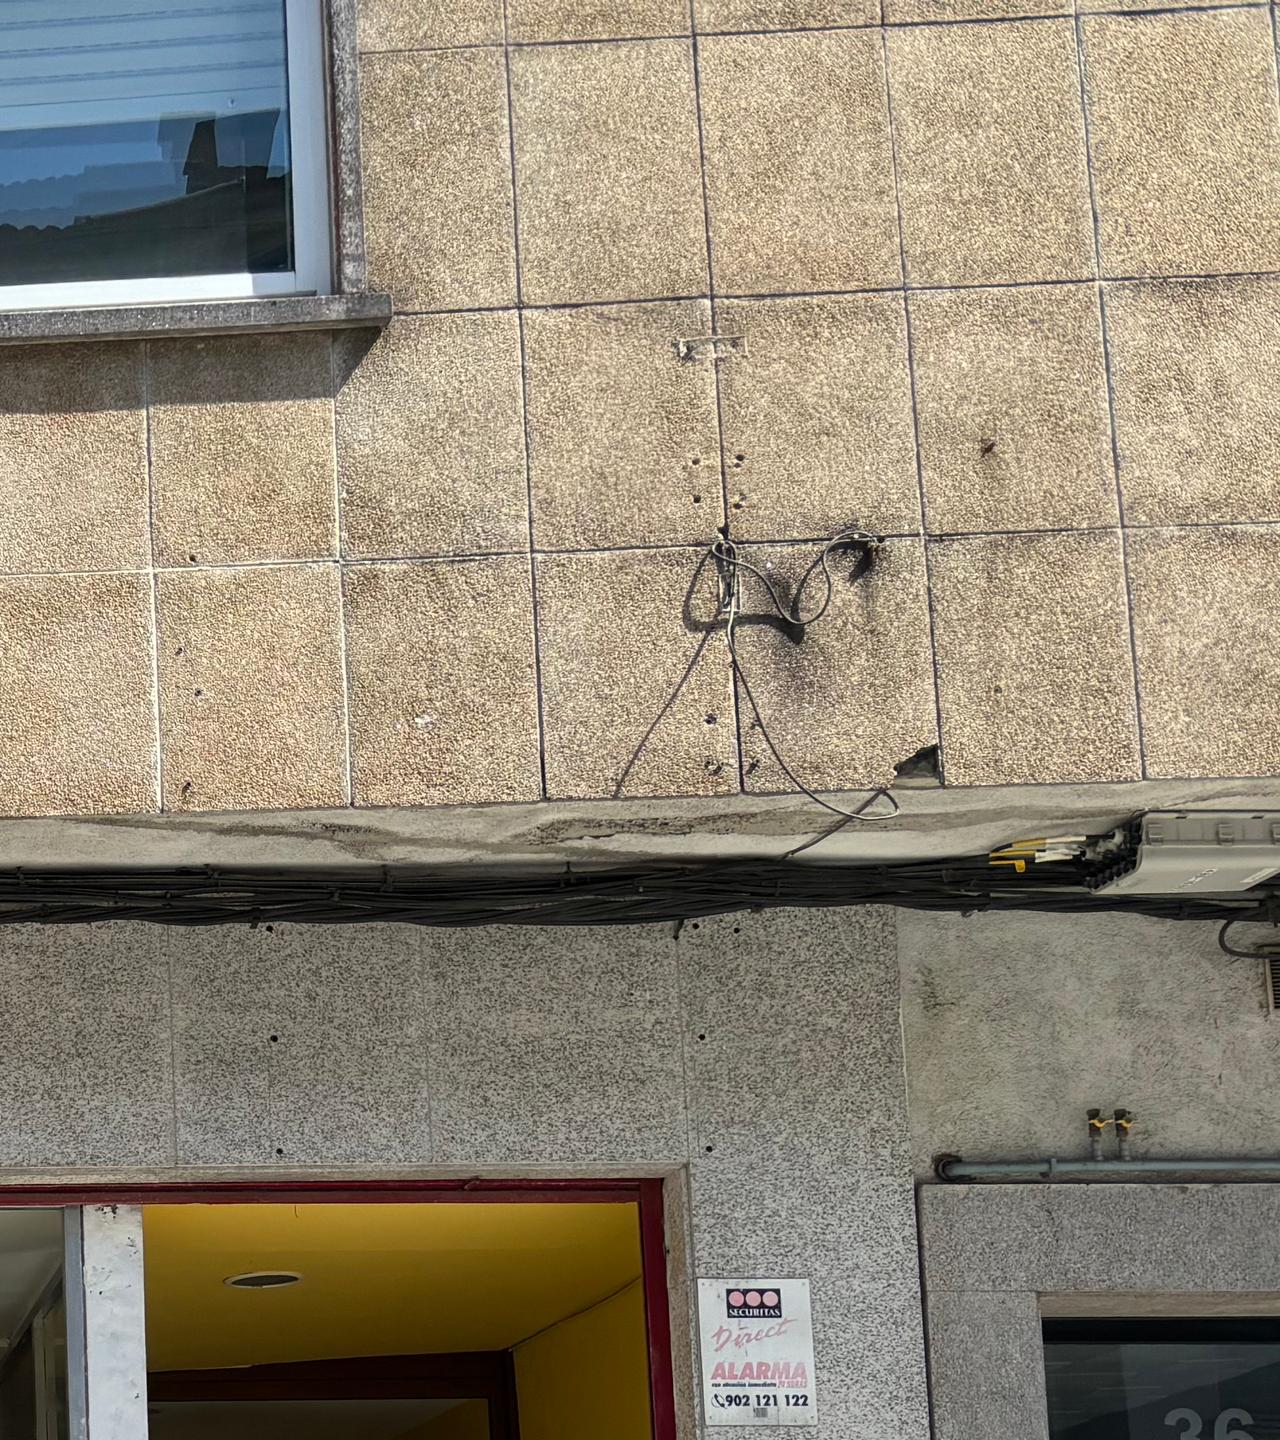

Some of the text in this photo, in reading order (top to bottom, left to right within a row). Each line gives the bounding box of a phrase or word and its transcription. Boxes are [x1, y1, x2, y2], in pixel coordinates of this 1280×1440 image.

[729, 1308, 781, 1317] SECURITAS
[712, 1318, 797, 1352] Direct
[711, 1361, 808, 1380] ALARMA
[725, 1395, 809, 1407] 902 121 122
